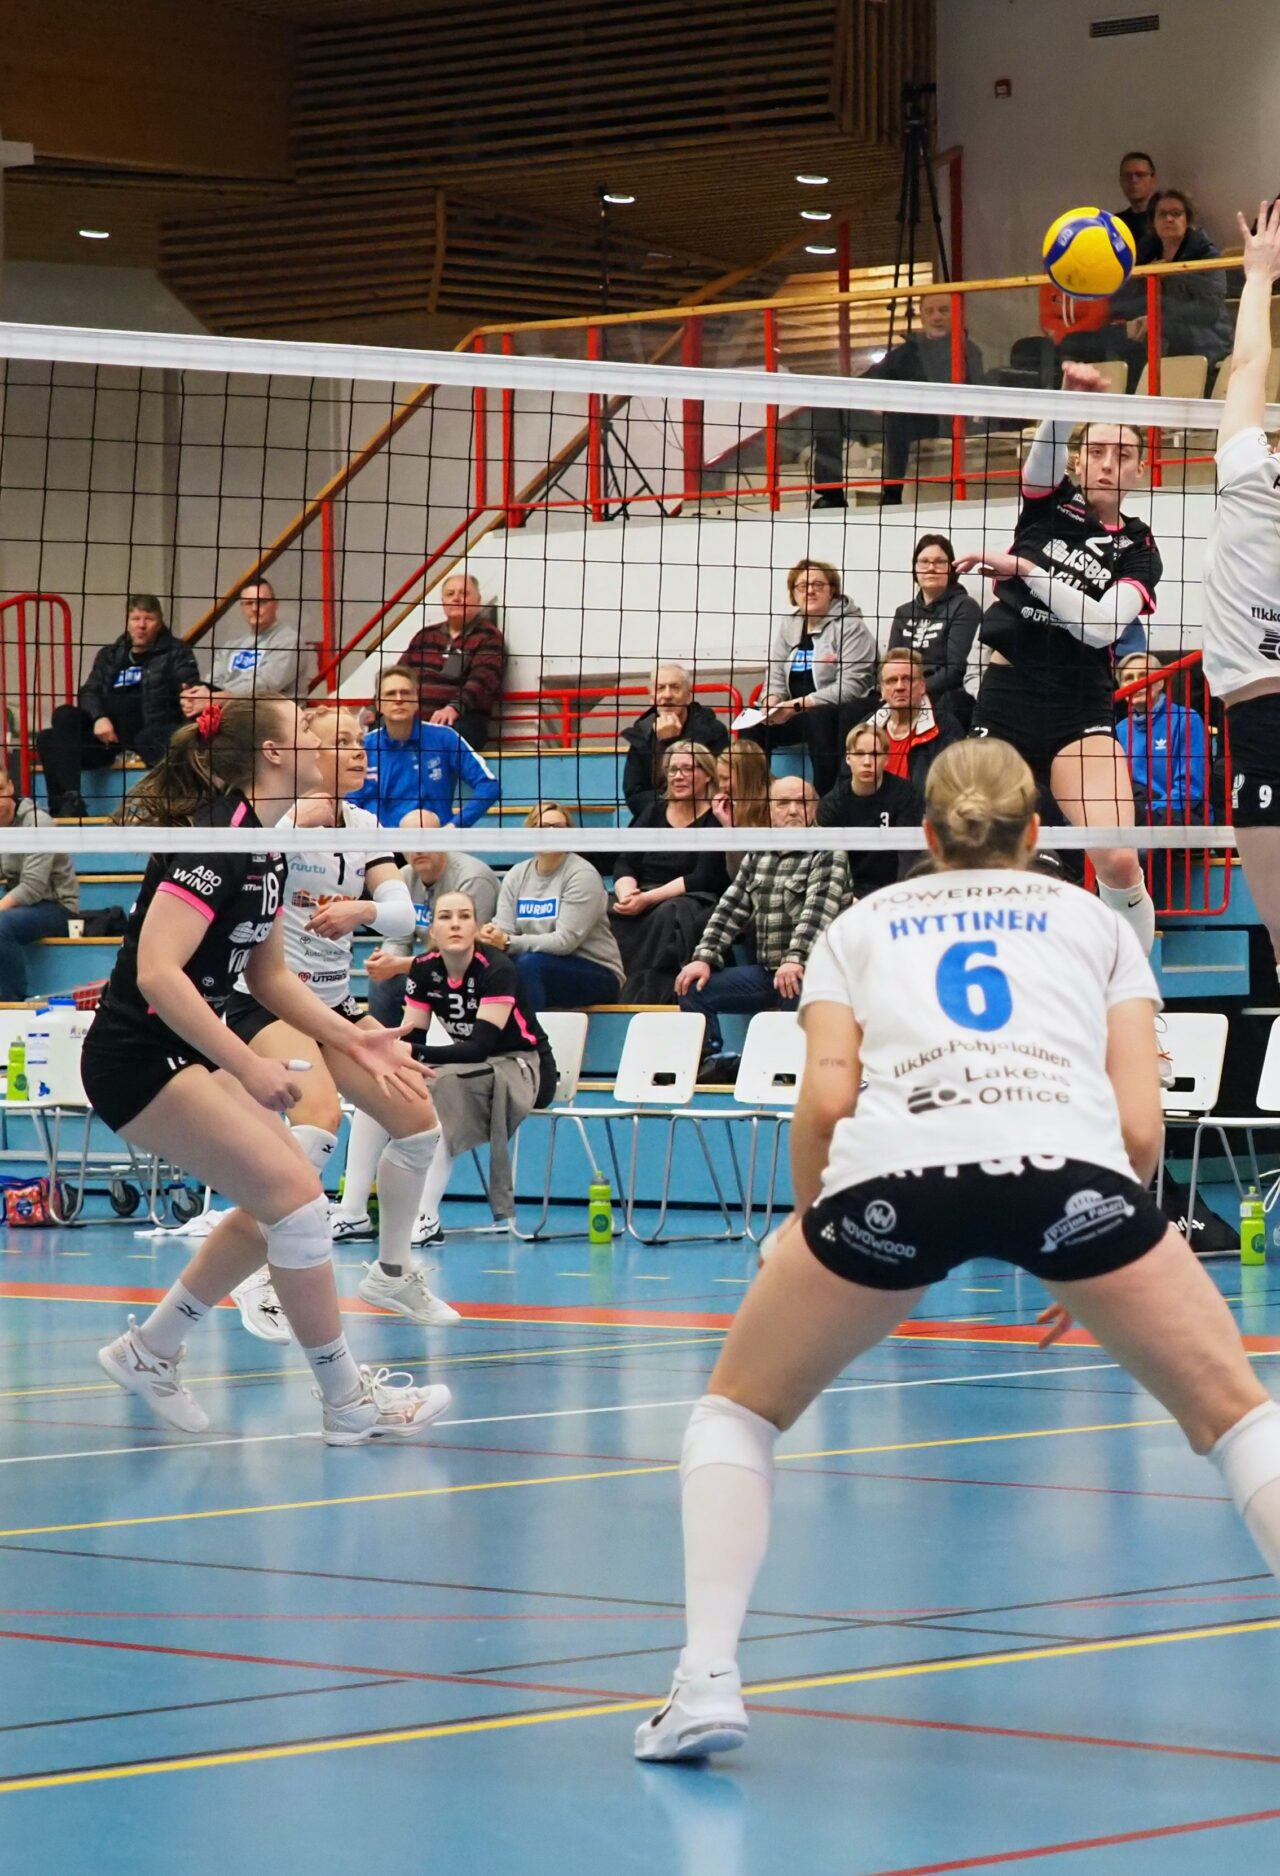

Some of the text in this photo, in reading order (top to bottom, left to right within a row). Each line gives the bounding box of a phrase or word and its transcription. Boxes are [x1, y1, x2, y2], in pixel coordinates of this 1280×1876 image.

[1259, 784, 1272, 808] 9
[192, 865, 222, 887] ABO
[291, 862, 326, 874] ruutu
[173, 868, 214, 895] WIND
[261, 872, 279, 916] 18
[520, 903, 554, 915] NURMO
[873, 884, 1064, 912] POWERPARK
[889, 909, 1048, 940] HYTTINEN
[935, 940, 1013, 1033] 6
[448, 993, 465, 1019] 3
[964, 1065, 1072, 1088] Lakeus
[979, 1086, 1071, 1105] Office
[842, 1215, 916, 1258] NOVOWOOD
